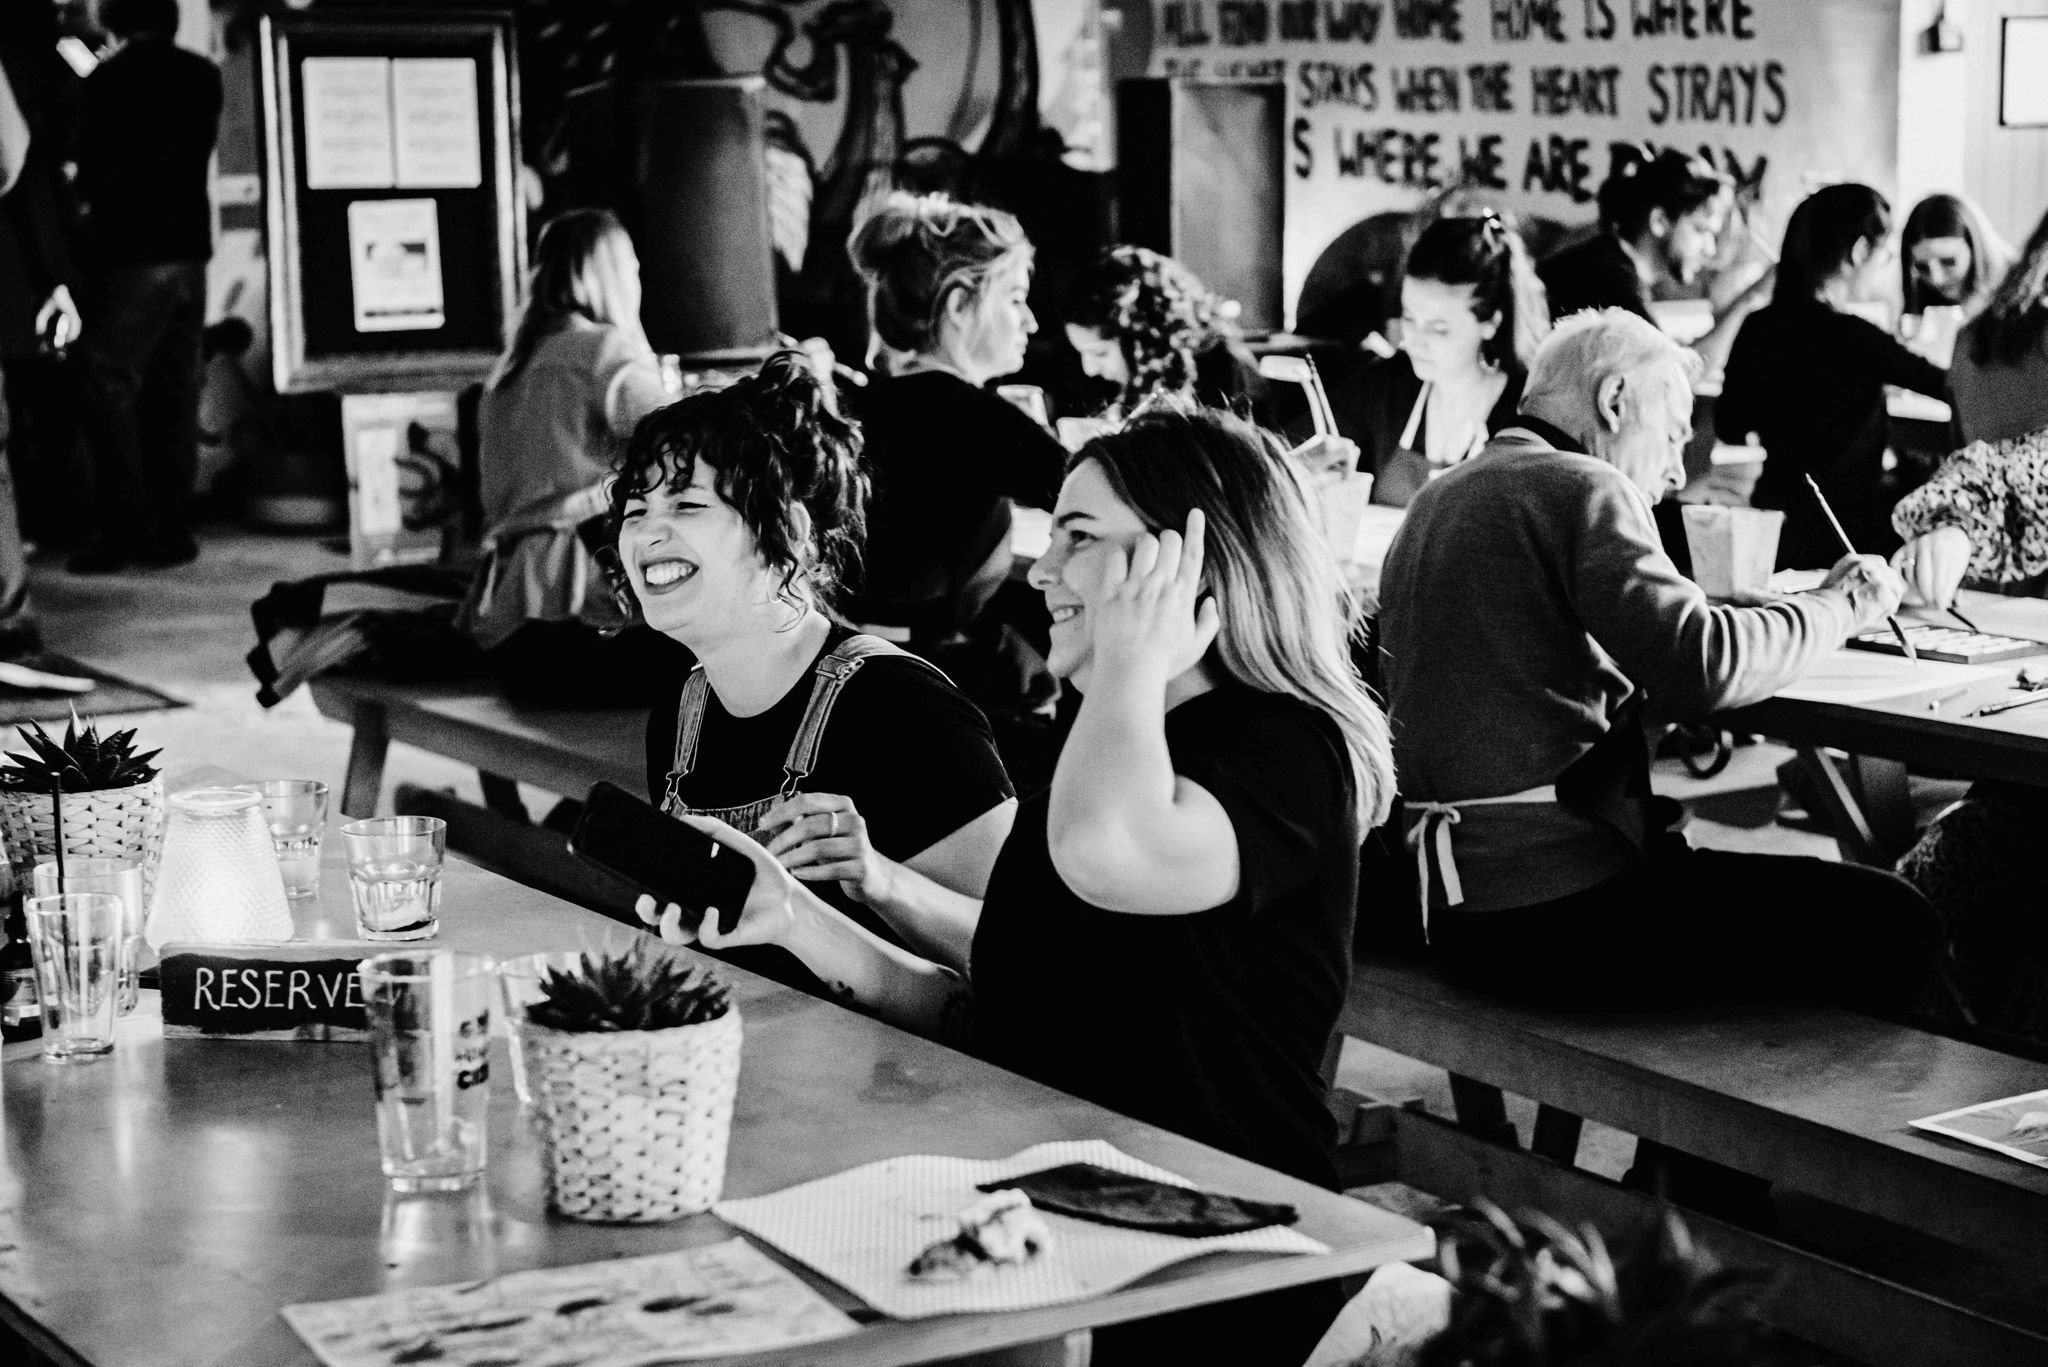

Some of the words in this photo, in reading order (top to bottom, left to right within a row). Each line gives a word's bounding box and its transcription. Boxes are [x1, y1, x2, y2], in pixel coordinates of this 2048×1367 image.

[1491, 0, 1566, 42] HOME
[1584, 0, 1616, 40] IS
[1632, 0, 1755, 39] WHERE
[1467, 62, 1512, 111] THE
[1531, 64, 1620, 116] HEART
[1647, 60, 1787, 124] STRAYS
[1334, 126, 1441, 187] WHERE
[1458, 133, 1507, 189] WE
[1522, 133, 1597, 203] ARE
